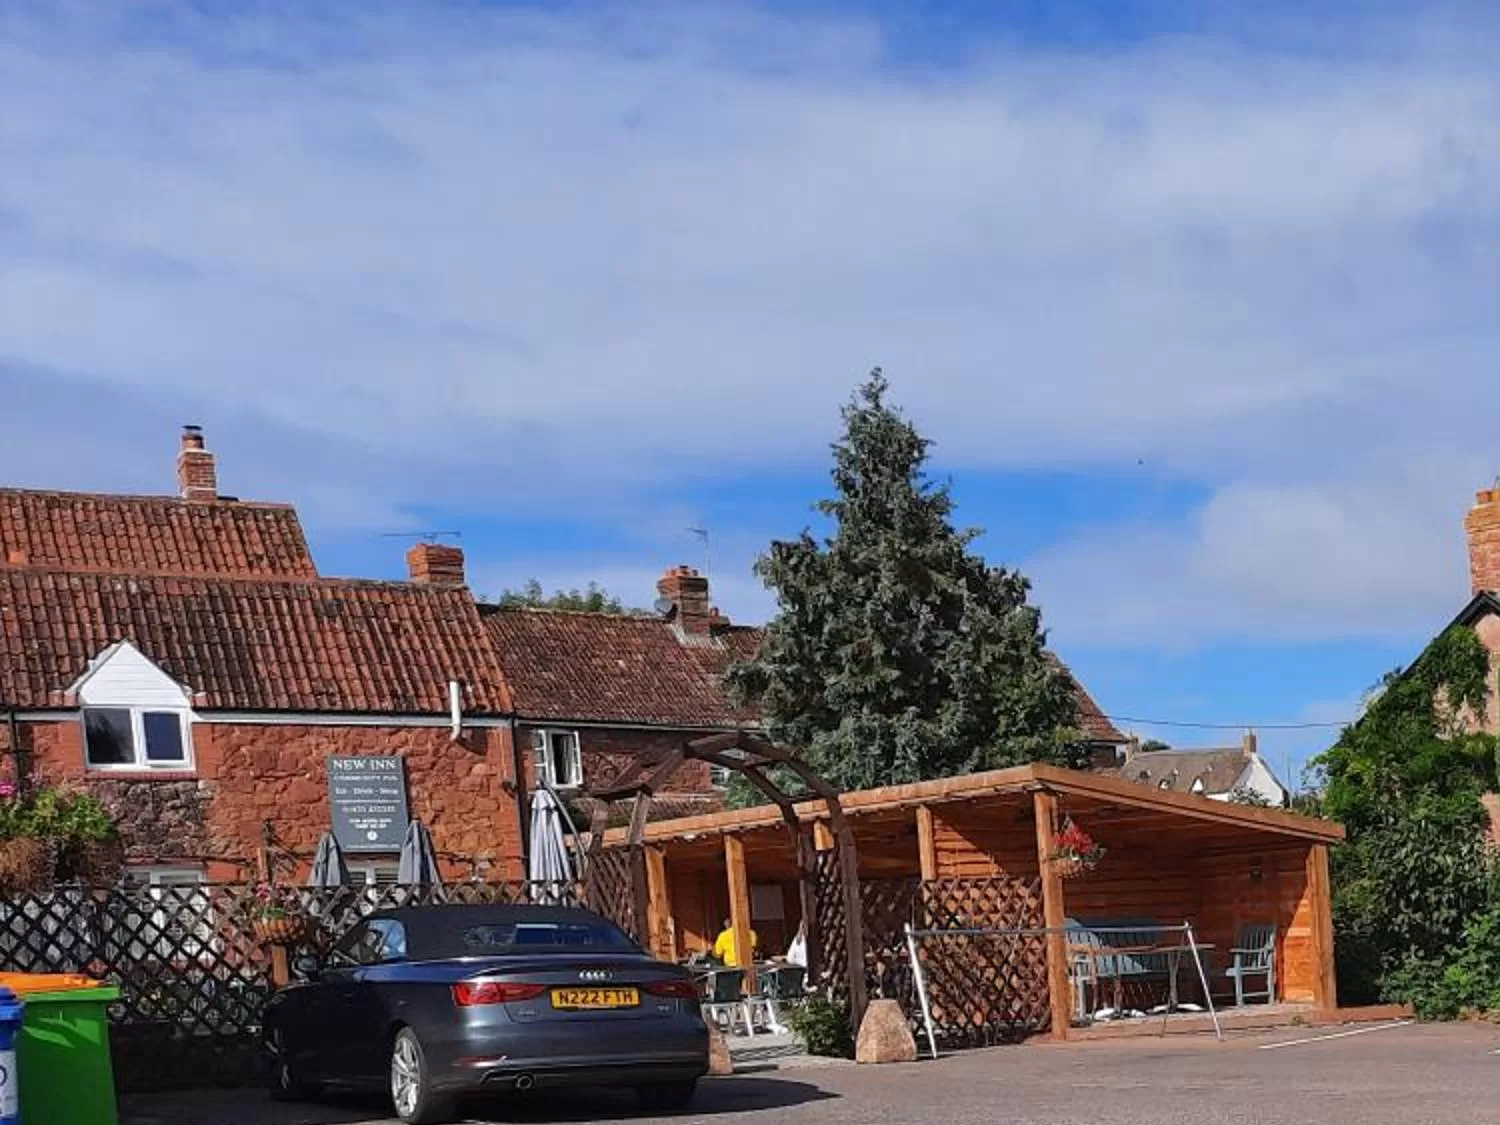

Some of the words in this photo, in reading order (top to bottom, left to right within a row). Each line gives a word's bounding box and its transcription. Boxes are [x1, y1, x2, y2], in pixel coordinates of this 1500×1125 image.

[333, 759, 366, 771] NEW
[369, 759, 397, 771] INN
[559, 991, 599, 1005] N222
